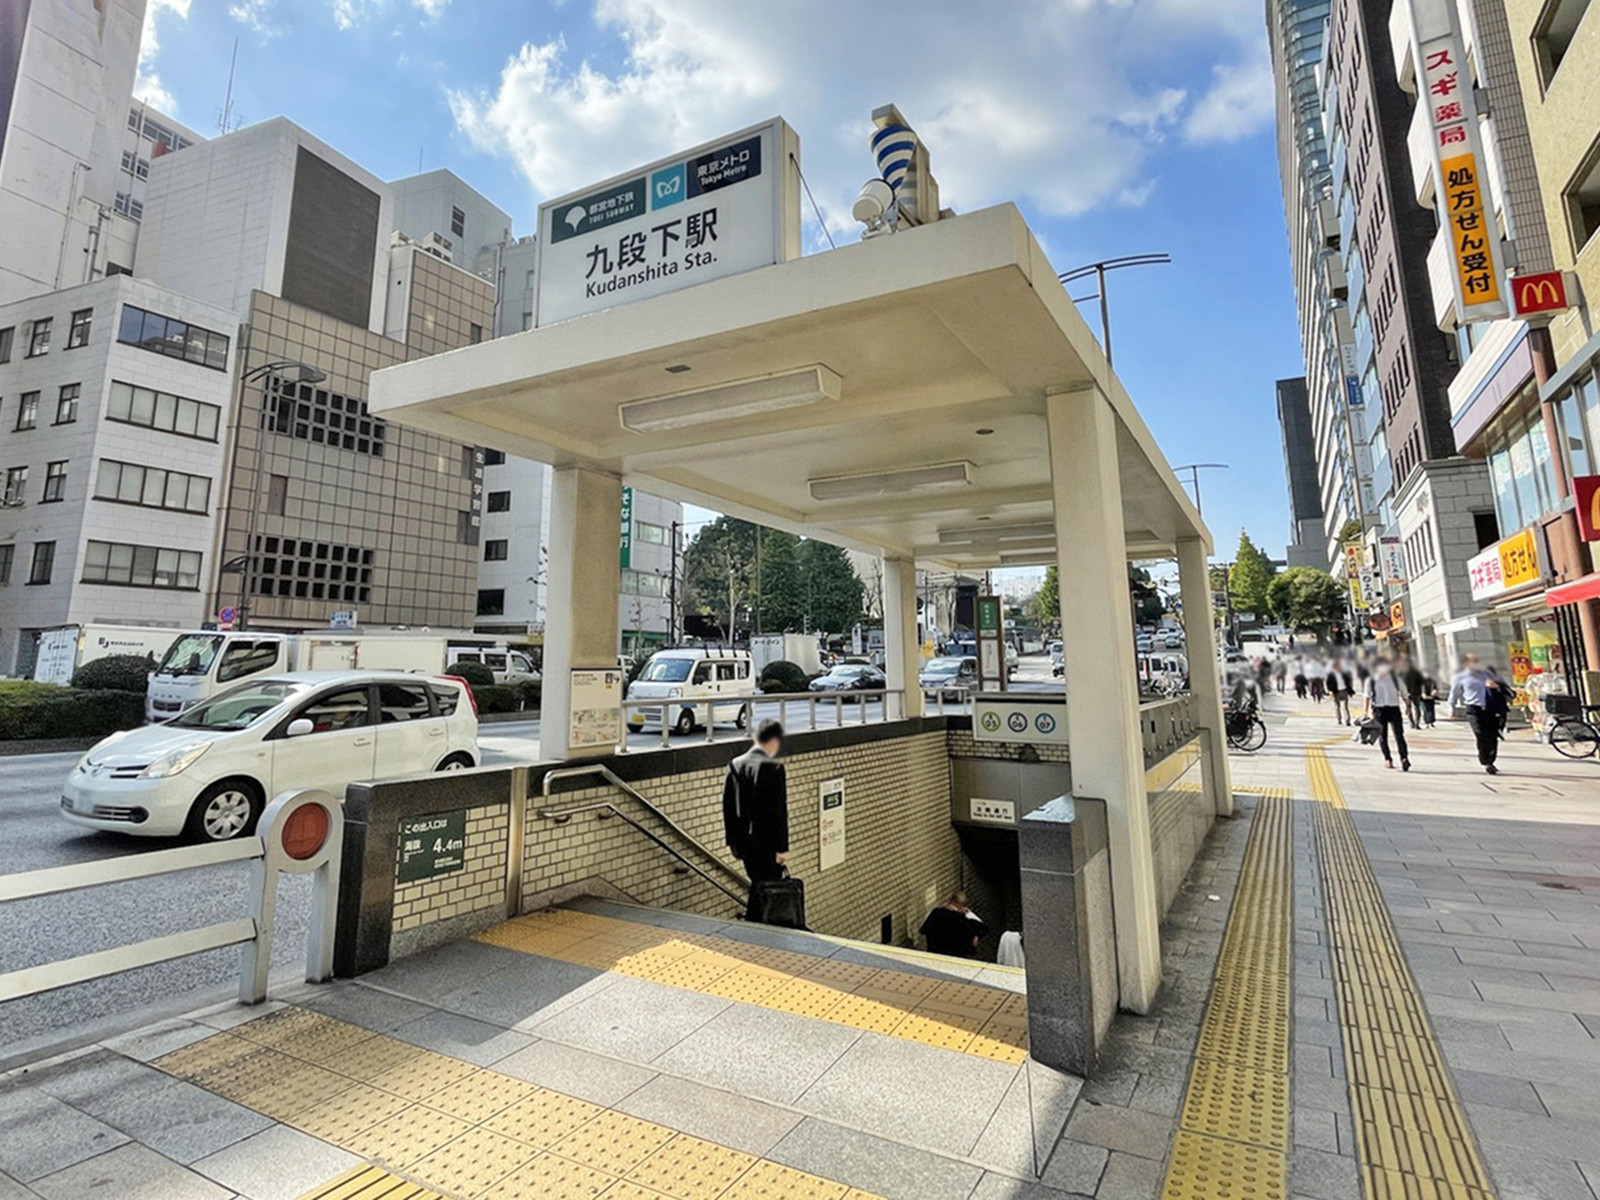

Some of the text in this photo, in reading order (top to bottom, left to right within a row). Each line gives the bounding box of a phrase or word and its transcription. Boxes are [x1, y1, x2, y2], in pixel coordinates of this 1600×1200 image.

[1426, 50, 1466, 147] スギ薬局
[697, 150, 750, 177] 東京メトロ
[700, 165, 747, 187] Tokyo Metro
[589, 191, 635, 215] 都営地下鉄
[605, 203, 635, 220] SUBWAY
[585, 207, 718, 279] 九段下駅
[1448, 167, 1490, 294] 処方せん受付
[585, 251, 718, 298] Kudanshita Sta.
[1471, 541, 1539, 591] スギ薬局 処方せん
[433, 837, 463, 853] 4.4m
